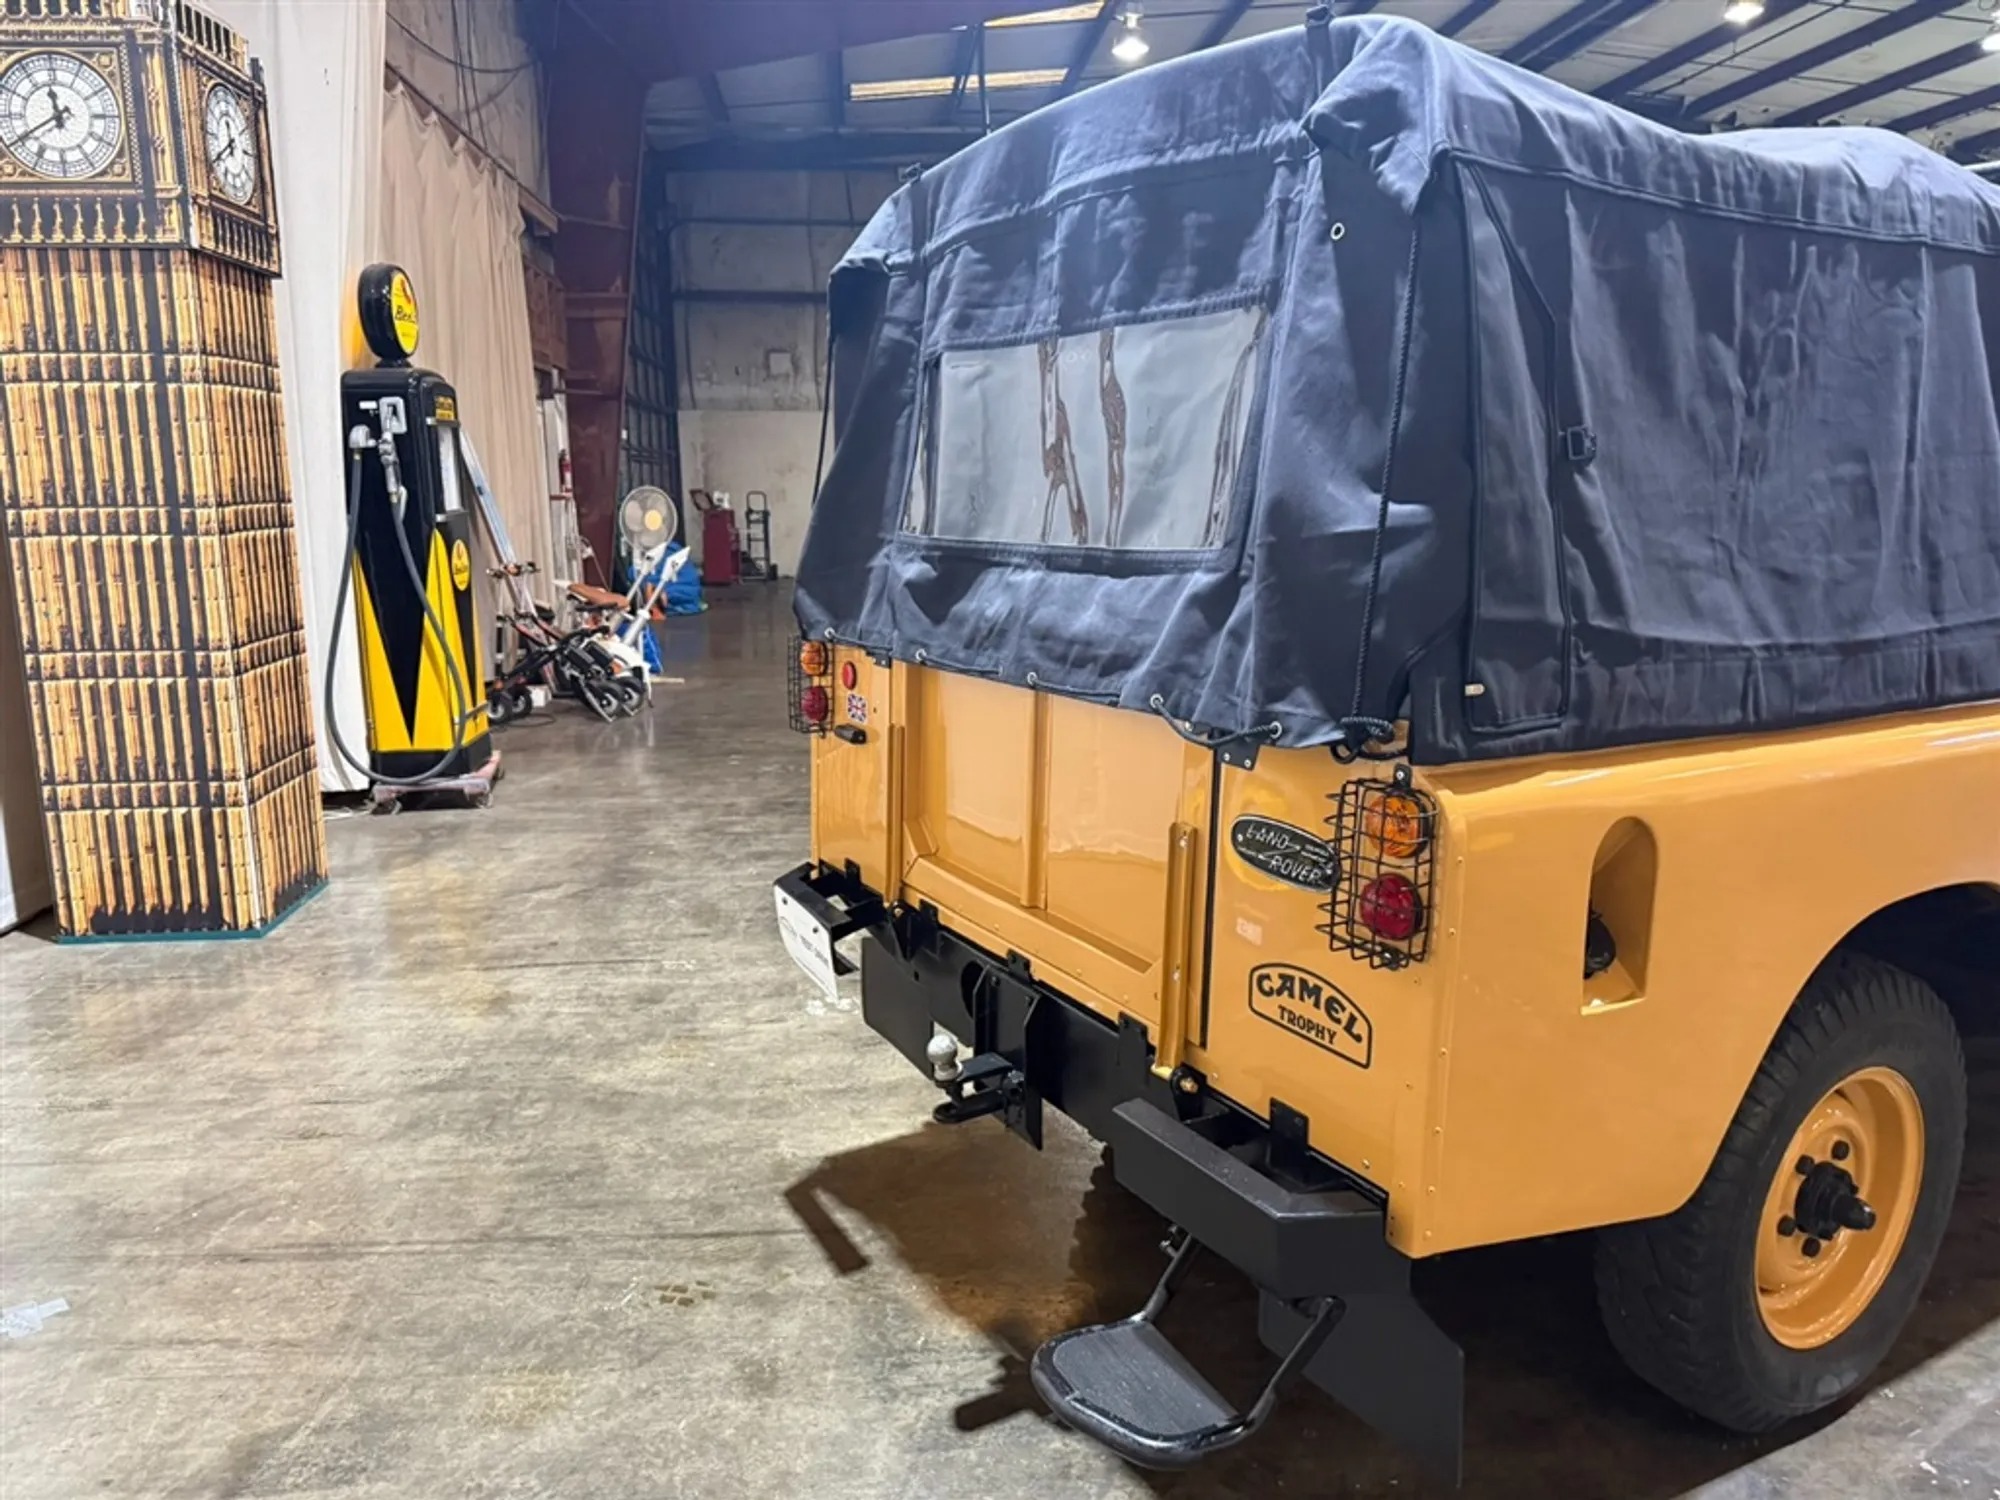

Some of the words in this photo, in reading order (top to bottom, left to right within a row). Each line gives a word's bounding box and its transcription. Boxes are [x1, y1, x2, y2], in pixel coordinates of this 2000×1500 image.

[1269, 855, 1322, 884] ROVER
[1256, 972, 1363, 1044] CAMEL
[1278, 1004, 1337, 1045] TROPHY
